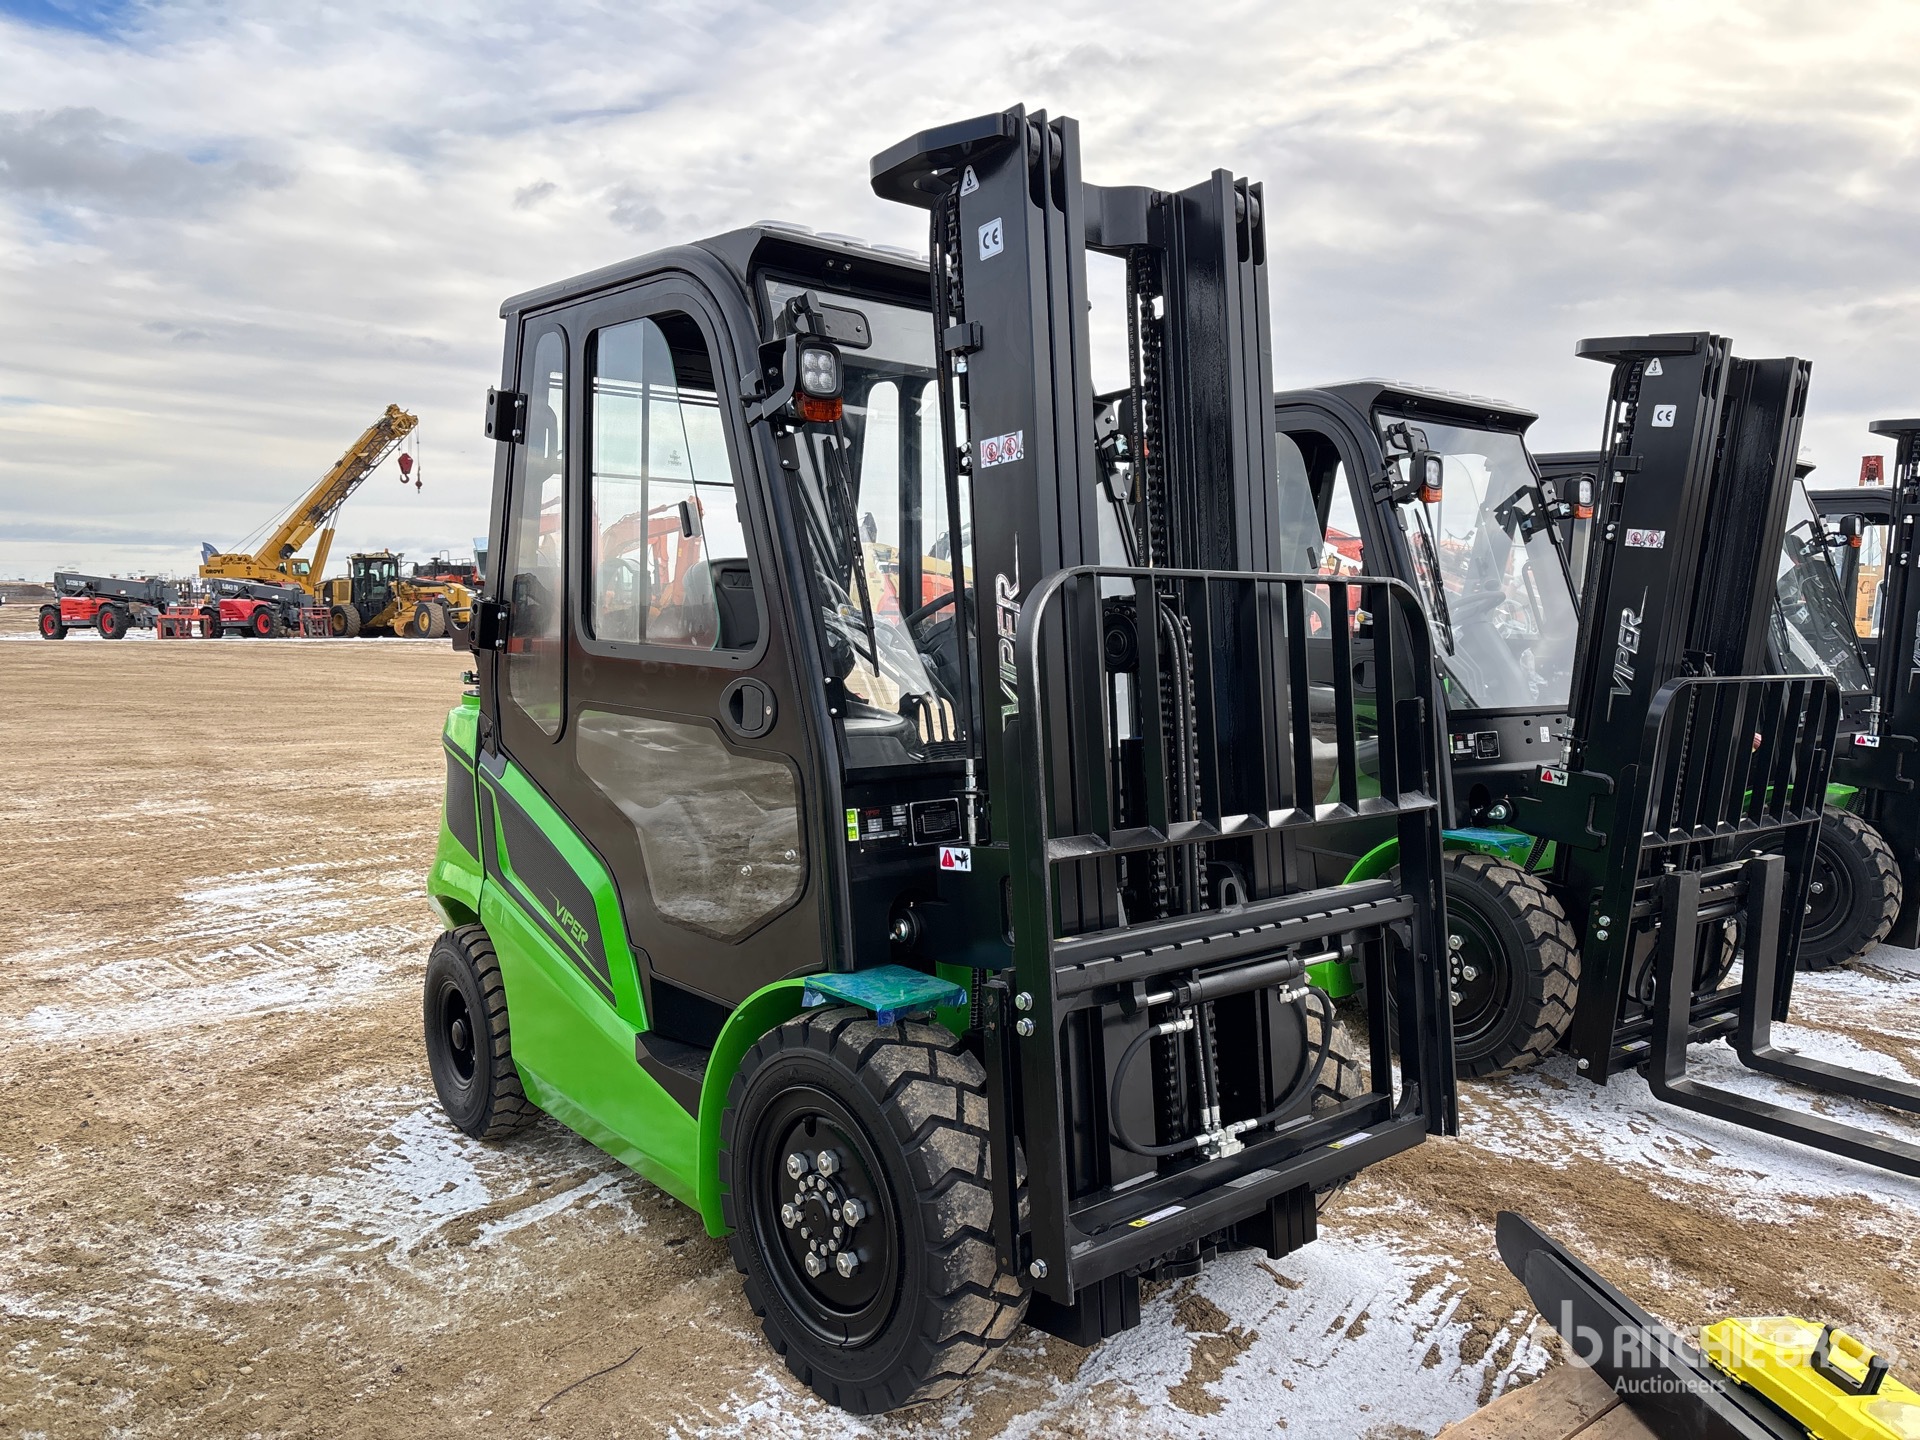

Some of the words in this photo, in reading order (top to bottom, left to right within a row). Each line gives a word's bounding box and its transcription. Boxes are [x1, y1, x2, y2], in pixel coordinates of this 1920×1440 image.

[983, 227, 999, 249] CE
[1657, 410, 1672, 421] CE
[996, 532, 1021, 733] VIPER
[1608, 592, 1646, 712] VIPER
[551, 893, 592, 951] VIPER
